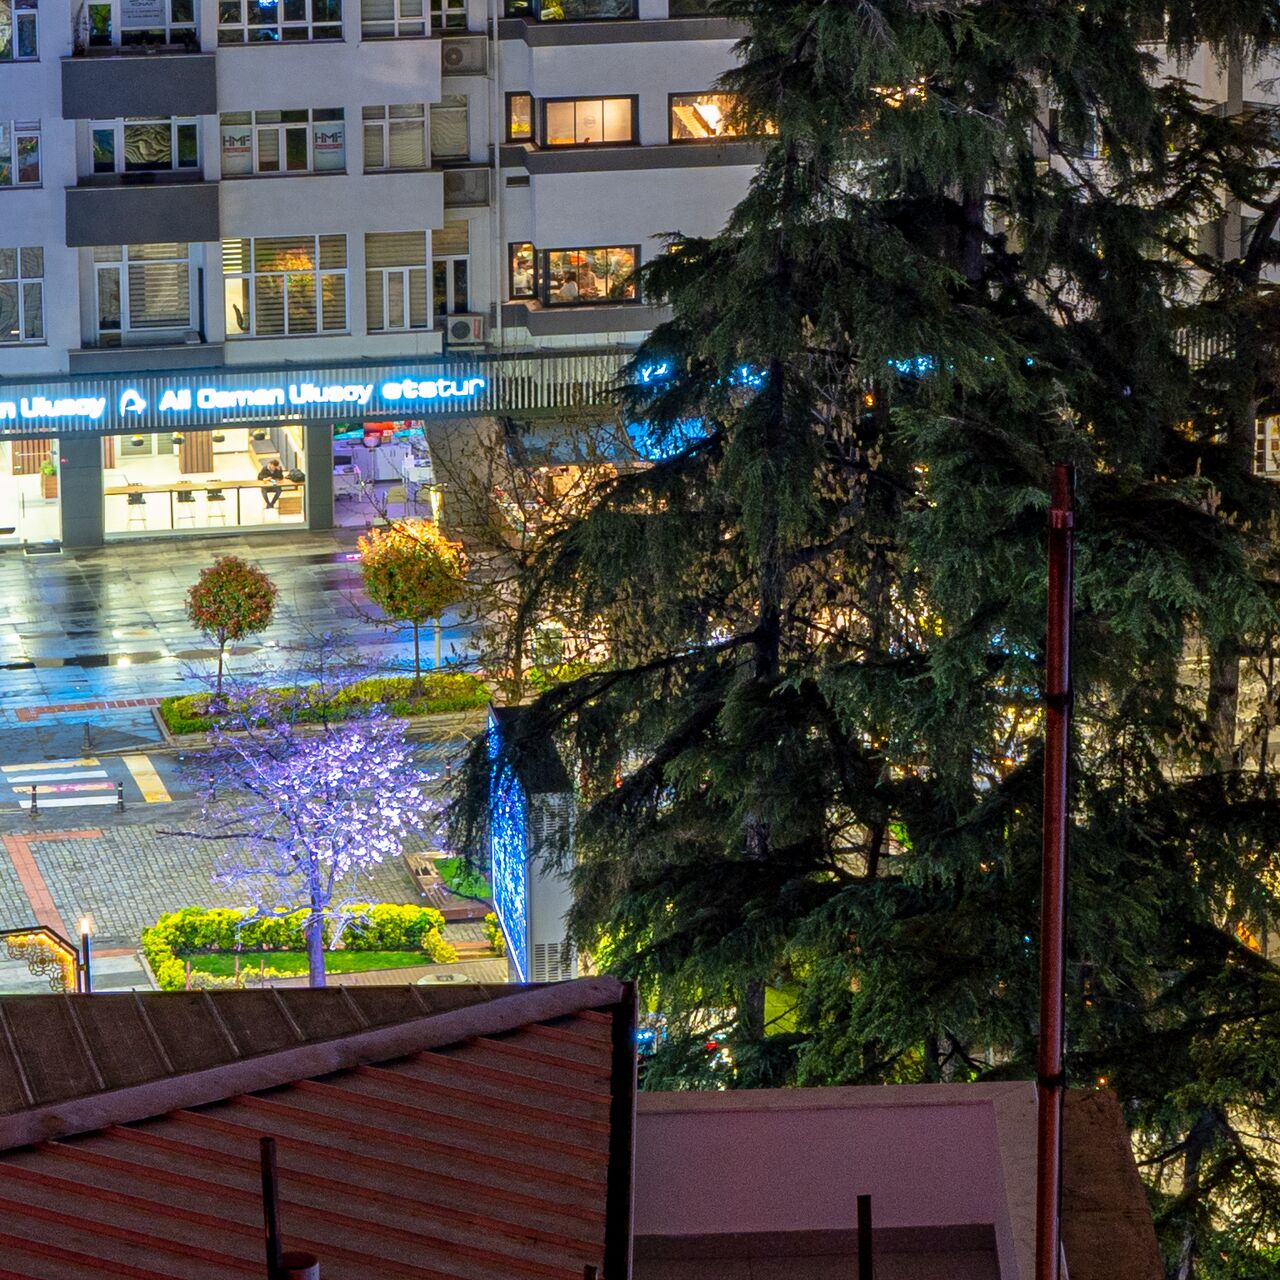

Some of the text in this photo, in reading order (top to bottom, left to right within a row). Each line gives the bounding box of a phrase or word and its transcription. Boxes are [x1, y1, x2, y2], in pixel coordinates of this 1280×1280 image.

[222, 135, 251, 147] HMF
[315, 131, 343, 143] HMF
[159, 388, 193, 412] Ali
[196, 387, 286, 410] Osman
[288, 383, 374, 406] Ulusoy
[20, 397, 107, 420] Ulusoy
